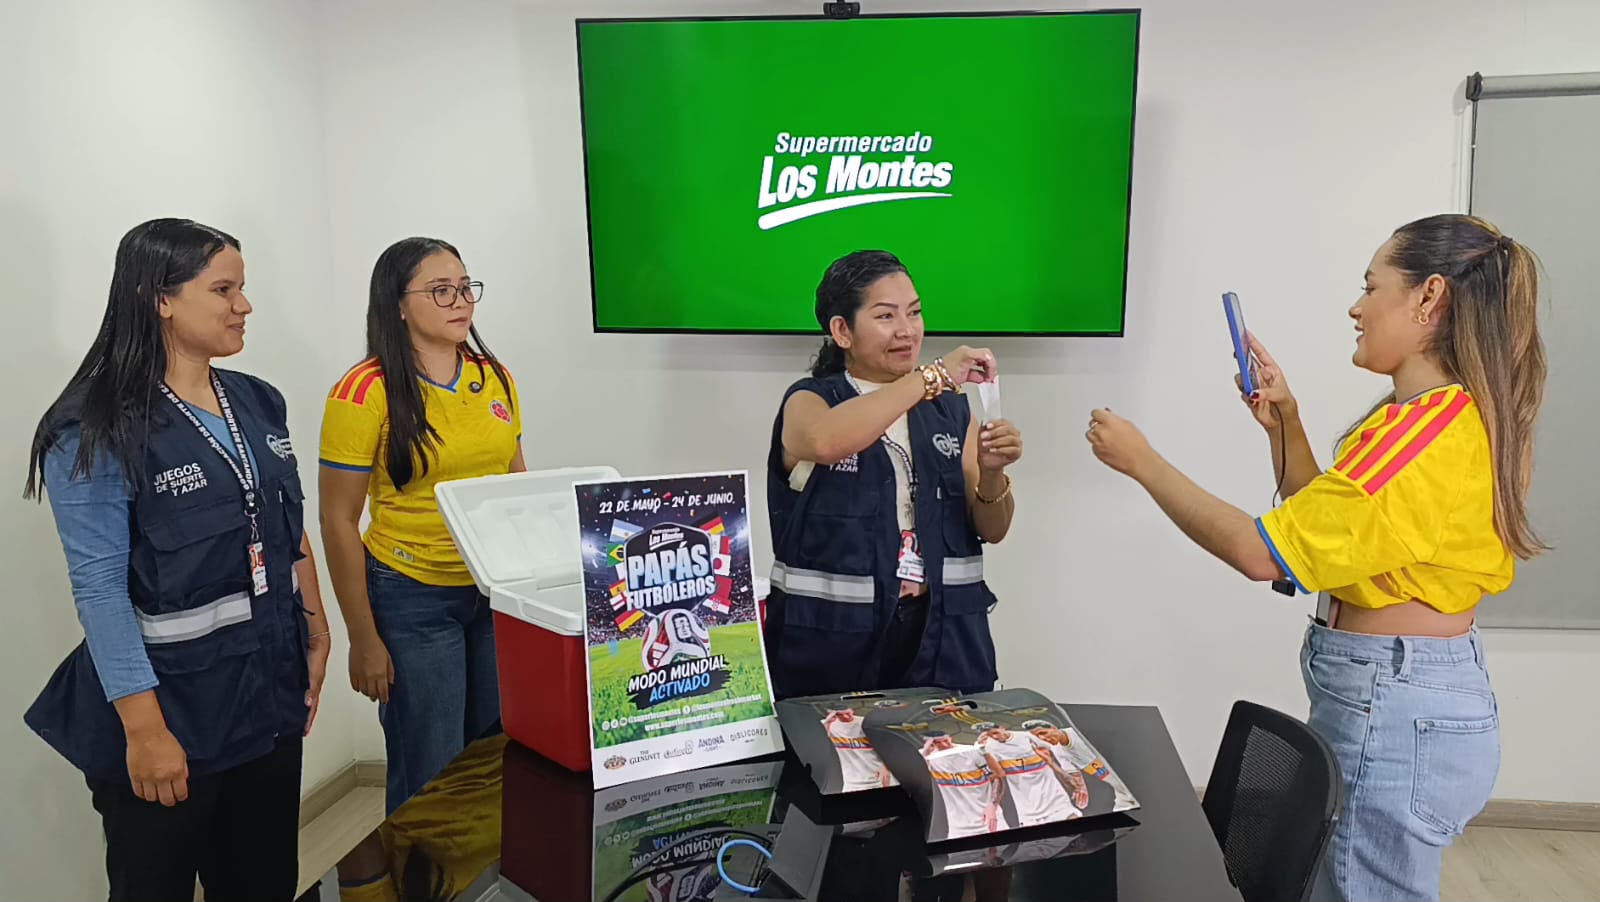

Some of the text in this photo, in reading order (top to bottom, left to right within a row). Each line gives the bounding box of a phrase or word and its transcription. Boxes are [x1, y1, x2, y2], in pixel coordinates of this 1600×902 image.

[775, 131, 932, 157] Supermercado
[758, 155, 953, 208] Los Montes
[154, 462, 201, 486] JUEGOS
[835, 463, 858, 472] AZAR
[156, 471, 204, 494] DE SUERTE
[171, 478, 208, 497] Y AZAR
[600, 501, 613, 514] 22
[616, 500, 630, 513] DE
[632, 498, 661, 514] MAYO
[671, 496, 683, 508] 24
[688, 495, 702, 507] DE
[627, 541, 709, 590] PAPÁS
[628, 655, 727, 693] MODO MUNDIAL
[649, 672, 710, 703] ACTIVADO
[1016, 758, 1024, 773] 7
